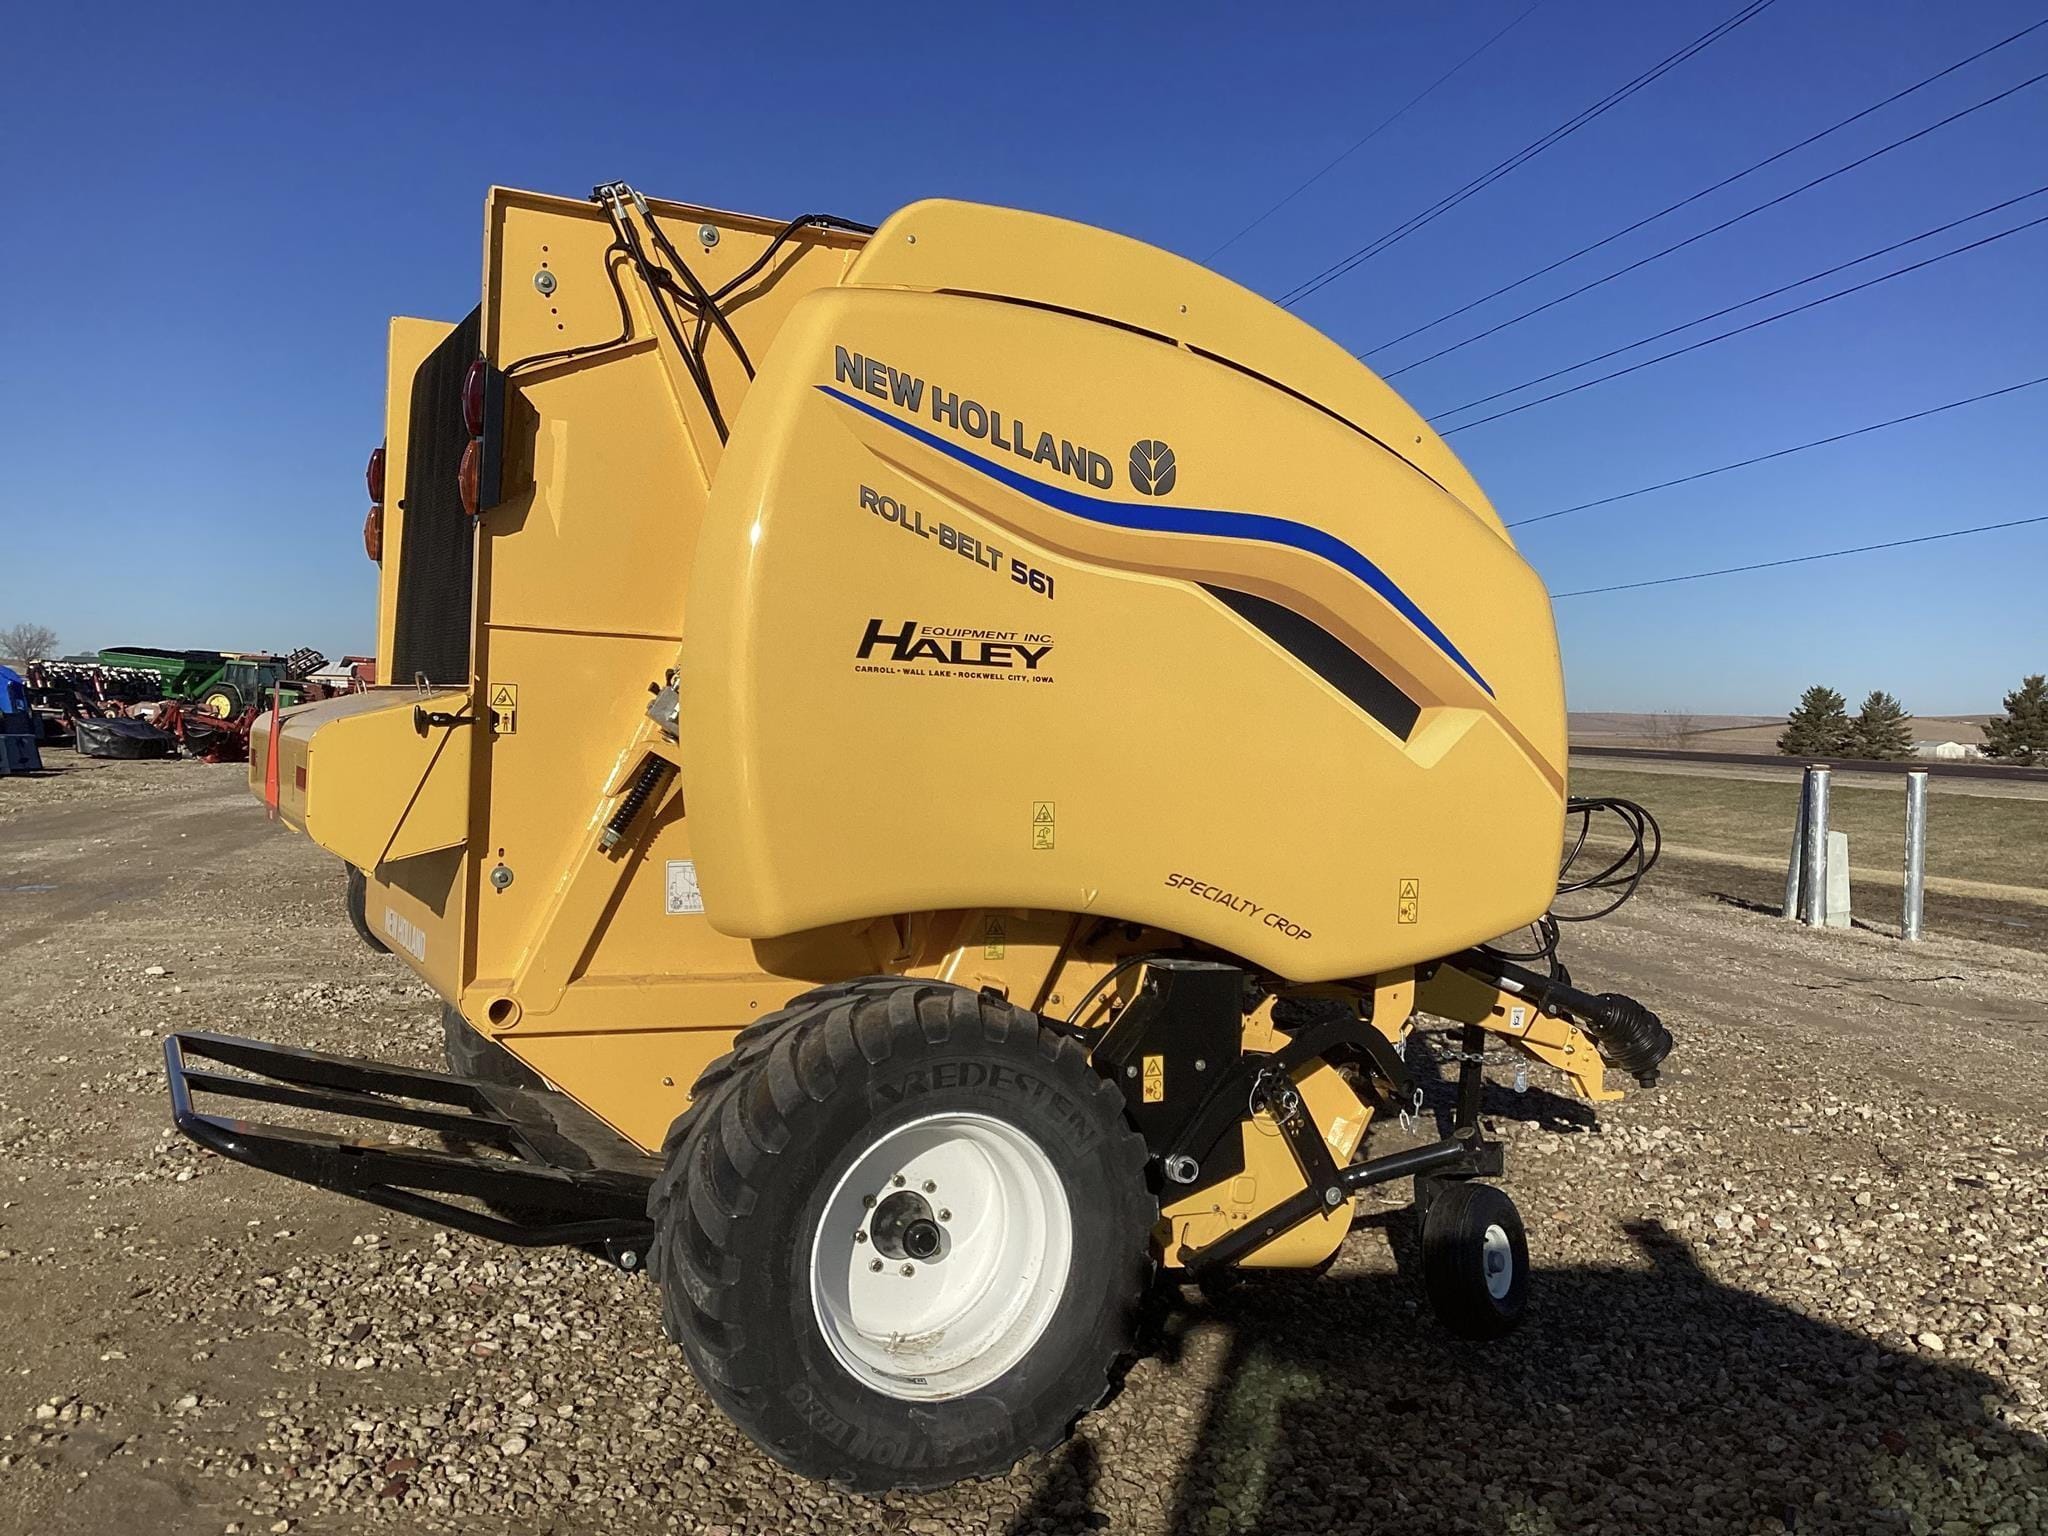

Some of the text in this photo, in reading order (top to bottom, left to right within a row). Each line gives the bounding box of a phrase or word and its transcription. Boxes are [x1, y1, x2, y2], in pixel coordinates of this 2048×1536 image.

[835, 345, 1114, 490] NEW HOLLAND
[859, 484, 1055, 600] ROLL-BELT 561
[855, 618, 1054, 670] HALEY
[921, 626, 1055, 644] EQUIPMENT INC.
[855, 665, 1054, 684] CARROLL WALL LAKE ROCKWELL CITY, IOWA
[1164, 873, 1313, 942] SPECIALTY CROP
